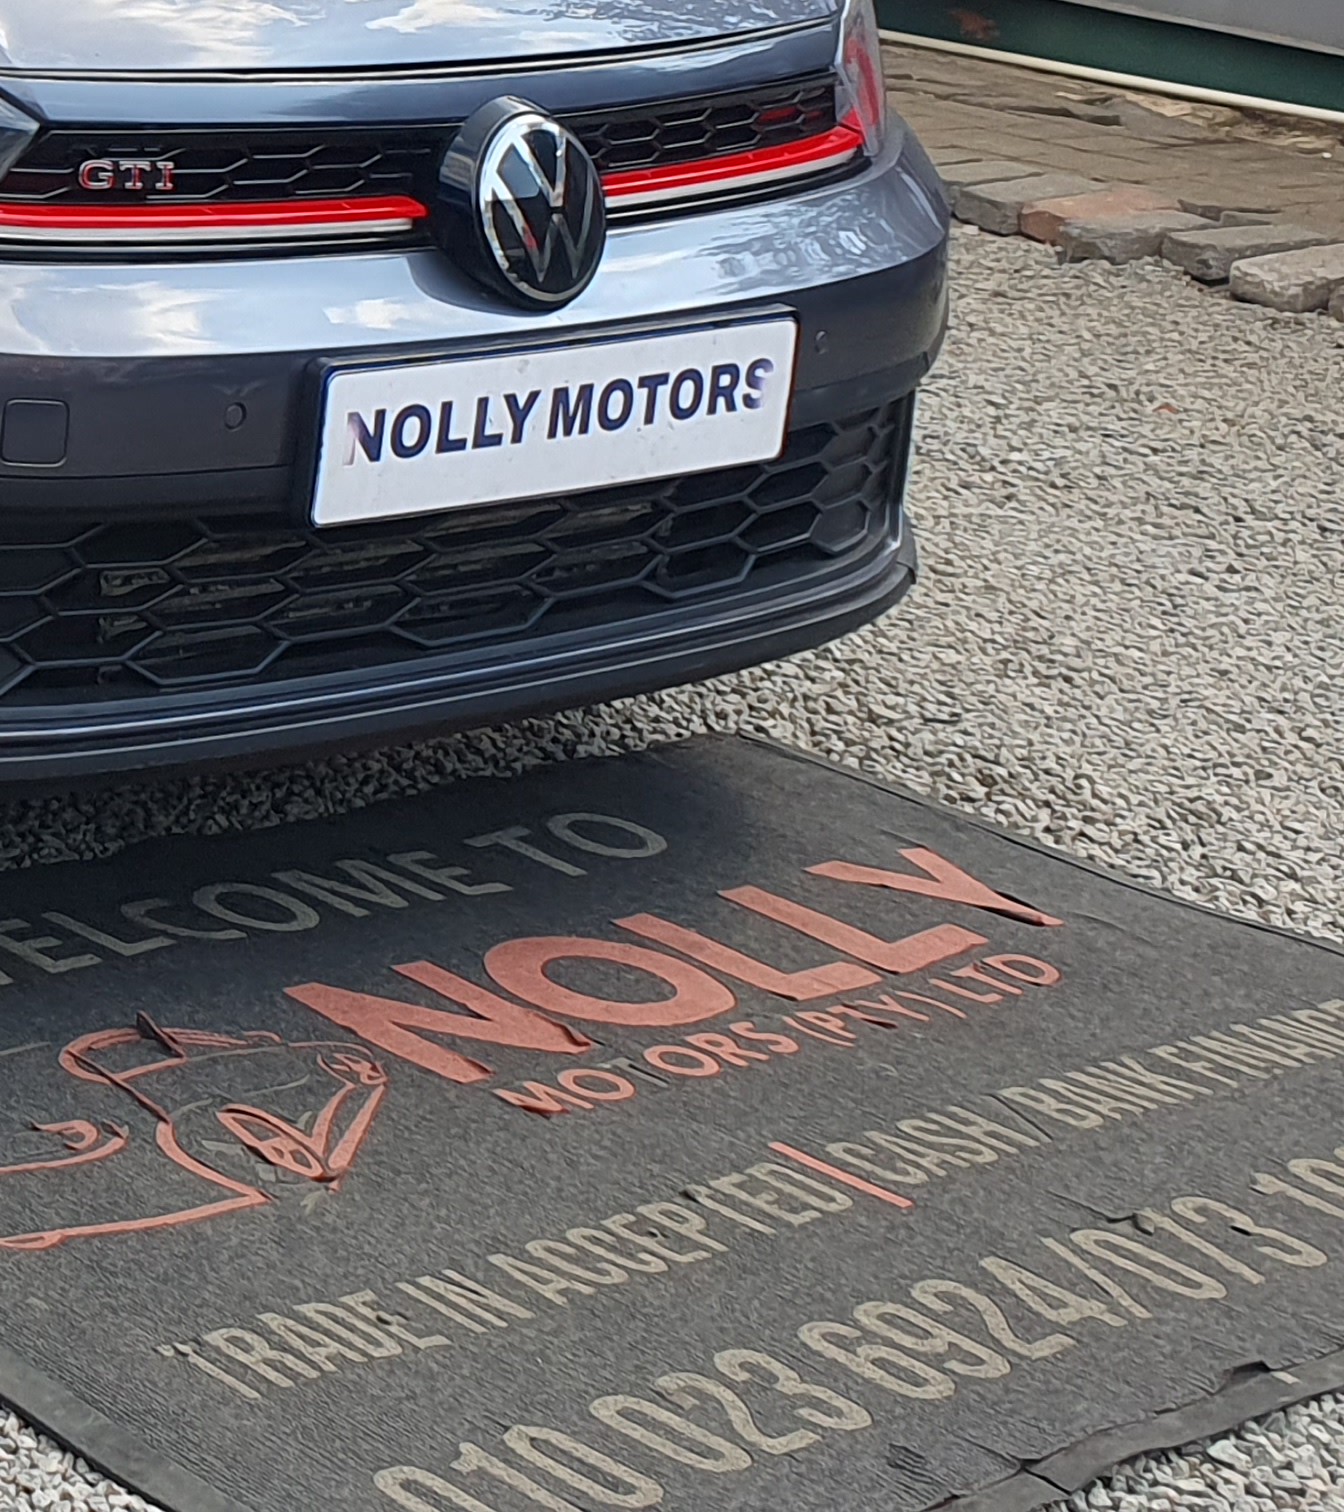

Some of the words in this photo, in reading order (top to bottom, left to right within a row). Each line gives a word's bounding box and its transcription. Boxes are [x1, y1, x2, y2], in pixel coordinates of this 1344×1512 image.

[78, 159, 175, 191] GTI
[342, 390, 542, 466] NOLLY
[546, 358, 775, 440] MOTORS
[463, 812, 668, 878] TO
[282, 844, 1065, 1084] NOLLY
[492, 1020, 800, 1115] MOTORS
[929, 952, 1062, 1004] LTD
[156, 1288, 452, 1400] TRADE
[396, 1268, 534, 1334] IN
[486, 1161, 854, 1306] ACCEPTED
[589, 1348, 873, 1473] 023
